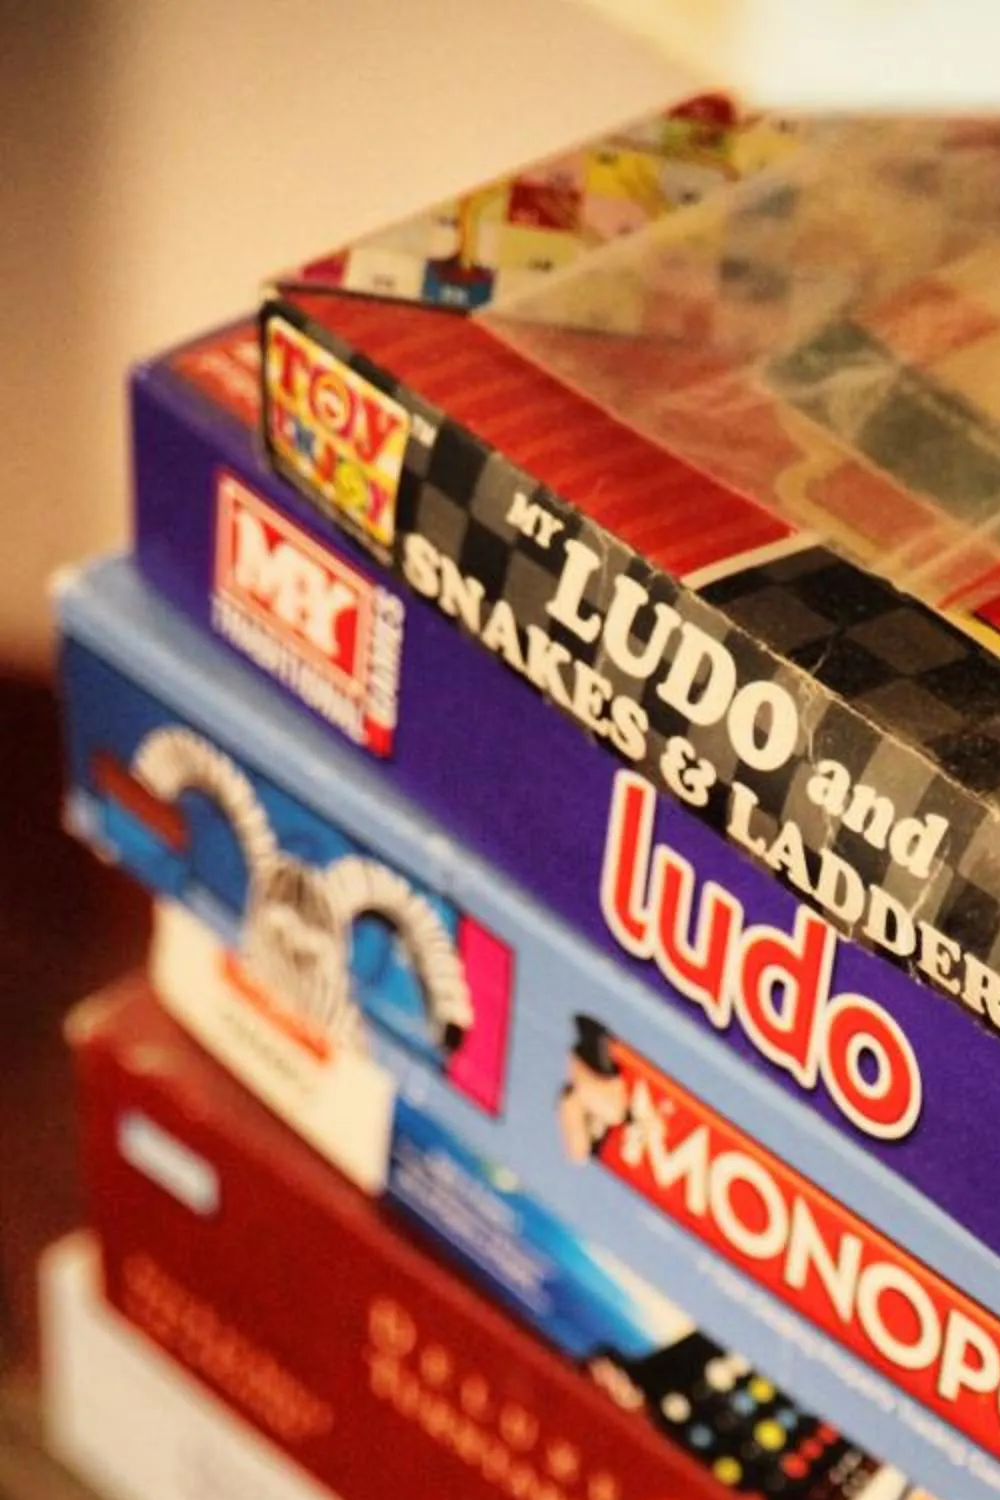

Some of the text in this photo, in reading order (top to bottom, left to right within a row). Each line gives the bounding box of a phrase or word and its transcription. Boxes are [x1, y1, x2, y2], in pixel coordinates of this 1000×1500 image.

[404, 534, 648, 760] SNAKES
[659, 736, 716, 806] &
[506, 493, 948, 878] MY LUDO and
[600, 768, 922, 1141] ludo
